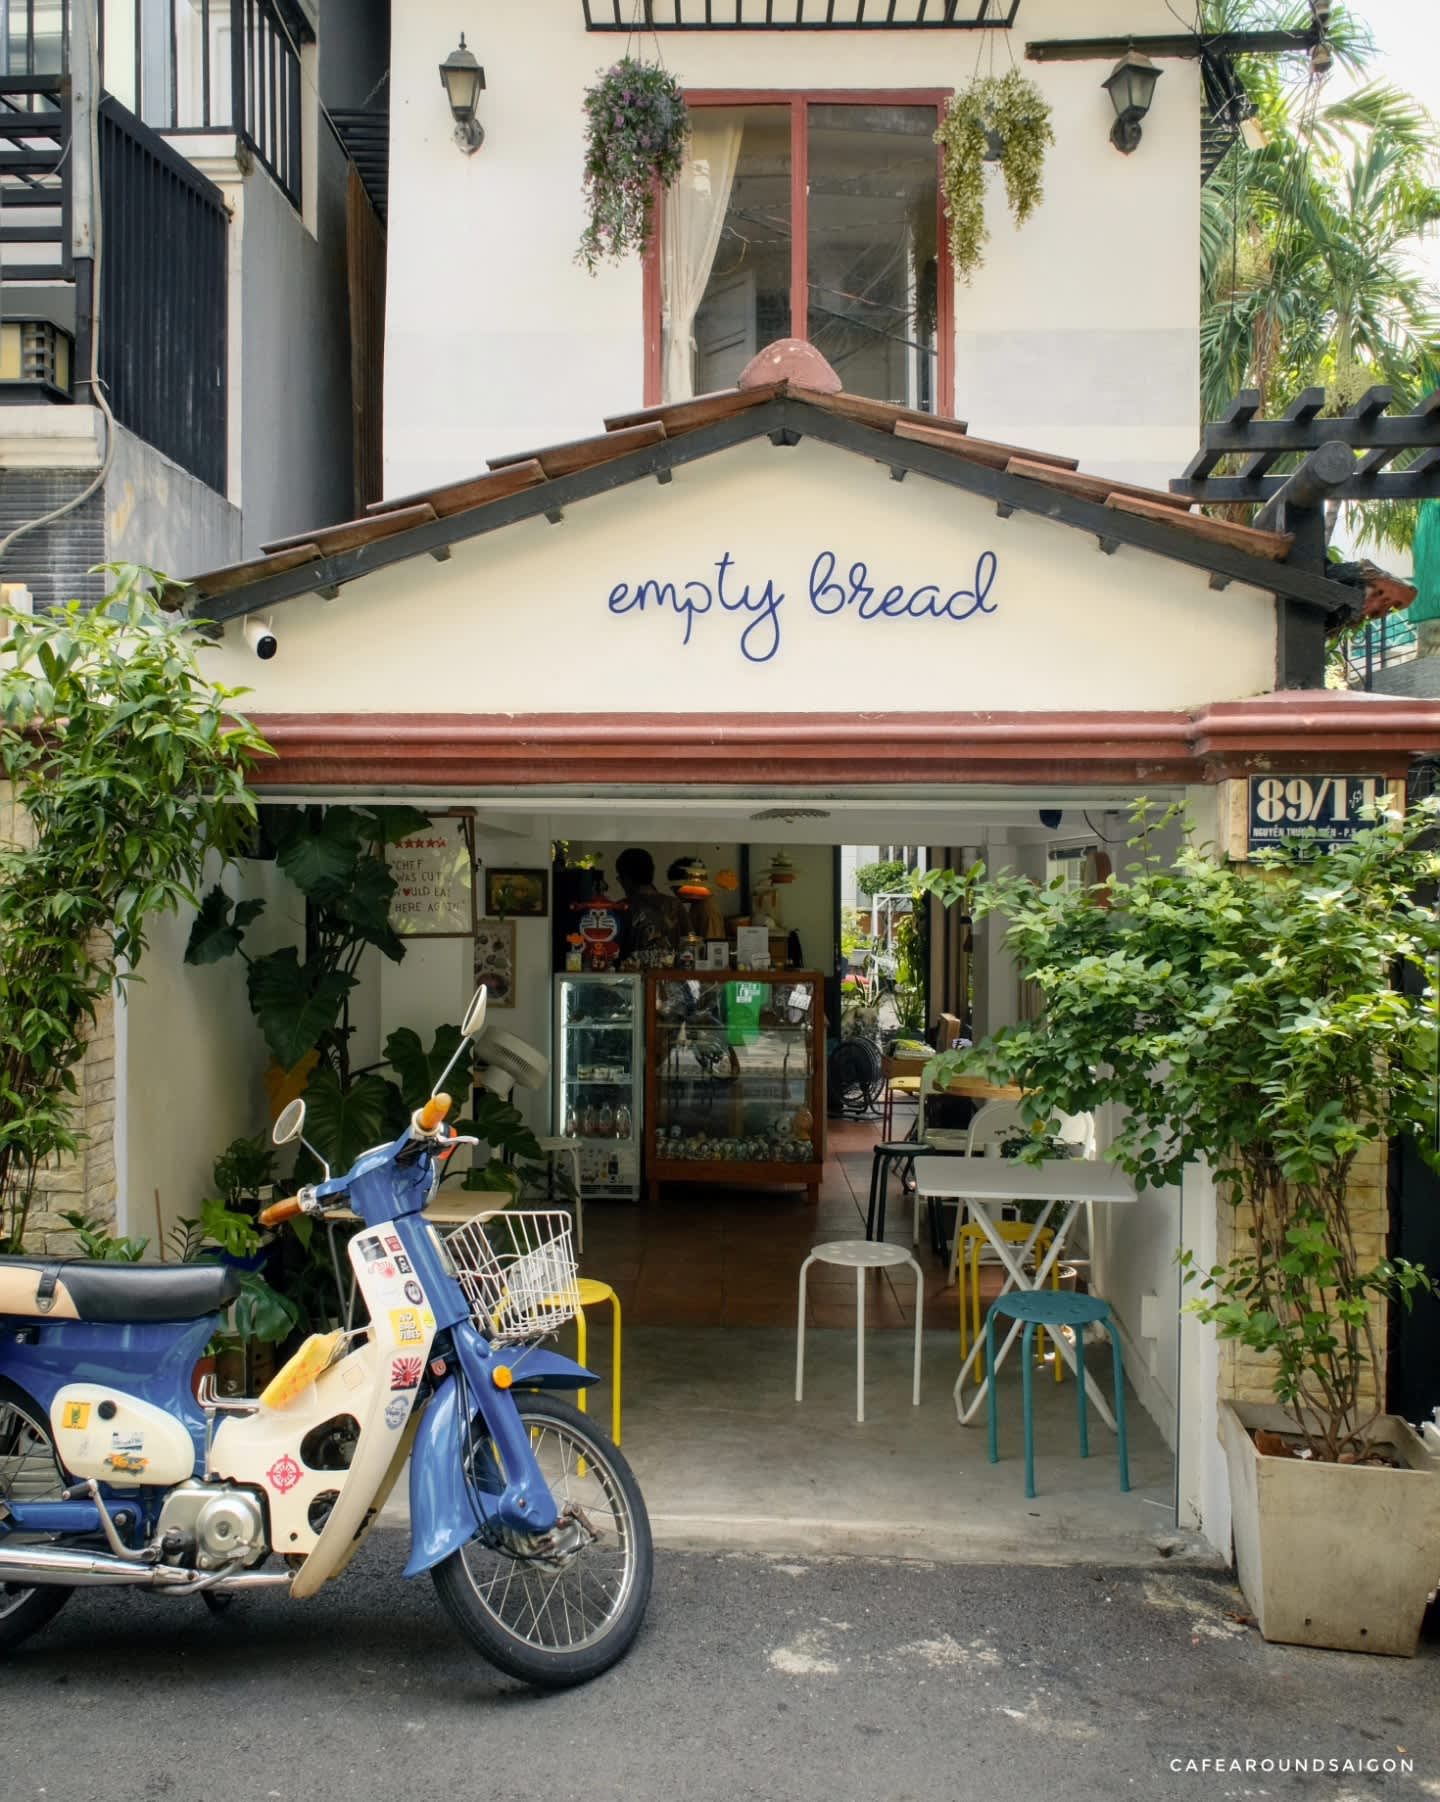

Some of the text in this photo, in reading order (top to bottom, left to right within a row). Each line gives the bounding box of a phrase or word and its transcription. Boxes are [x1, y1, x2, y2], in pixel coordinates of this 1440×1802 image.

[608, 550, 998, 662] empty bread
[1256, 778, 1377, 822] 89/11
[394, 902, 423, 913] HERE
